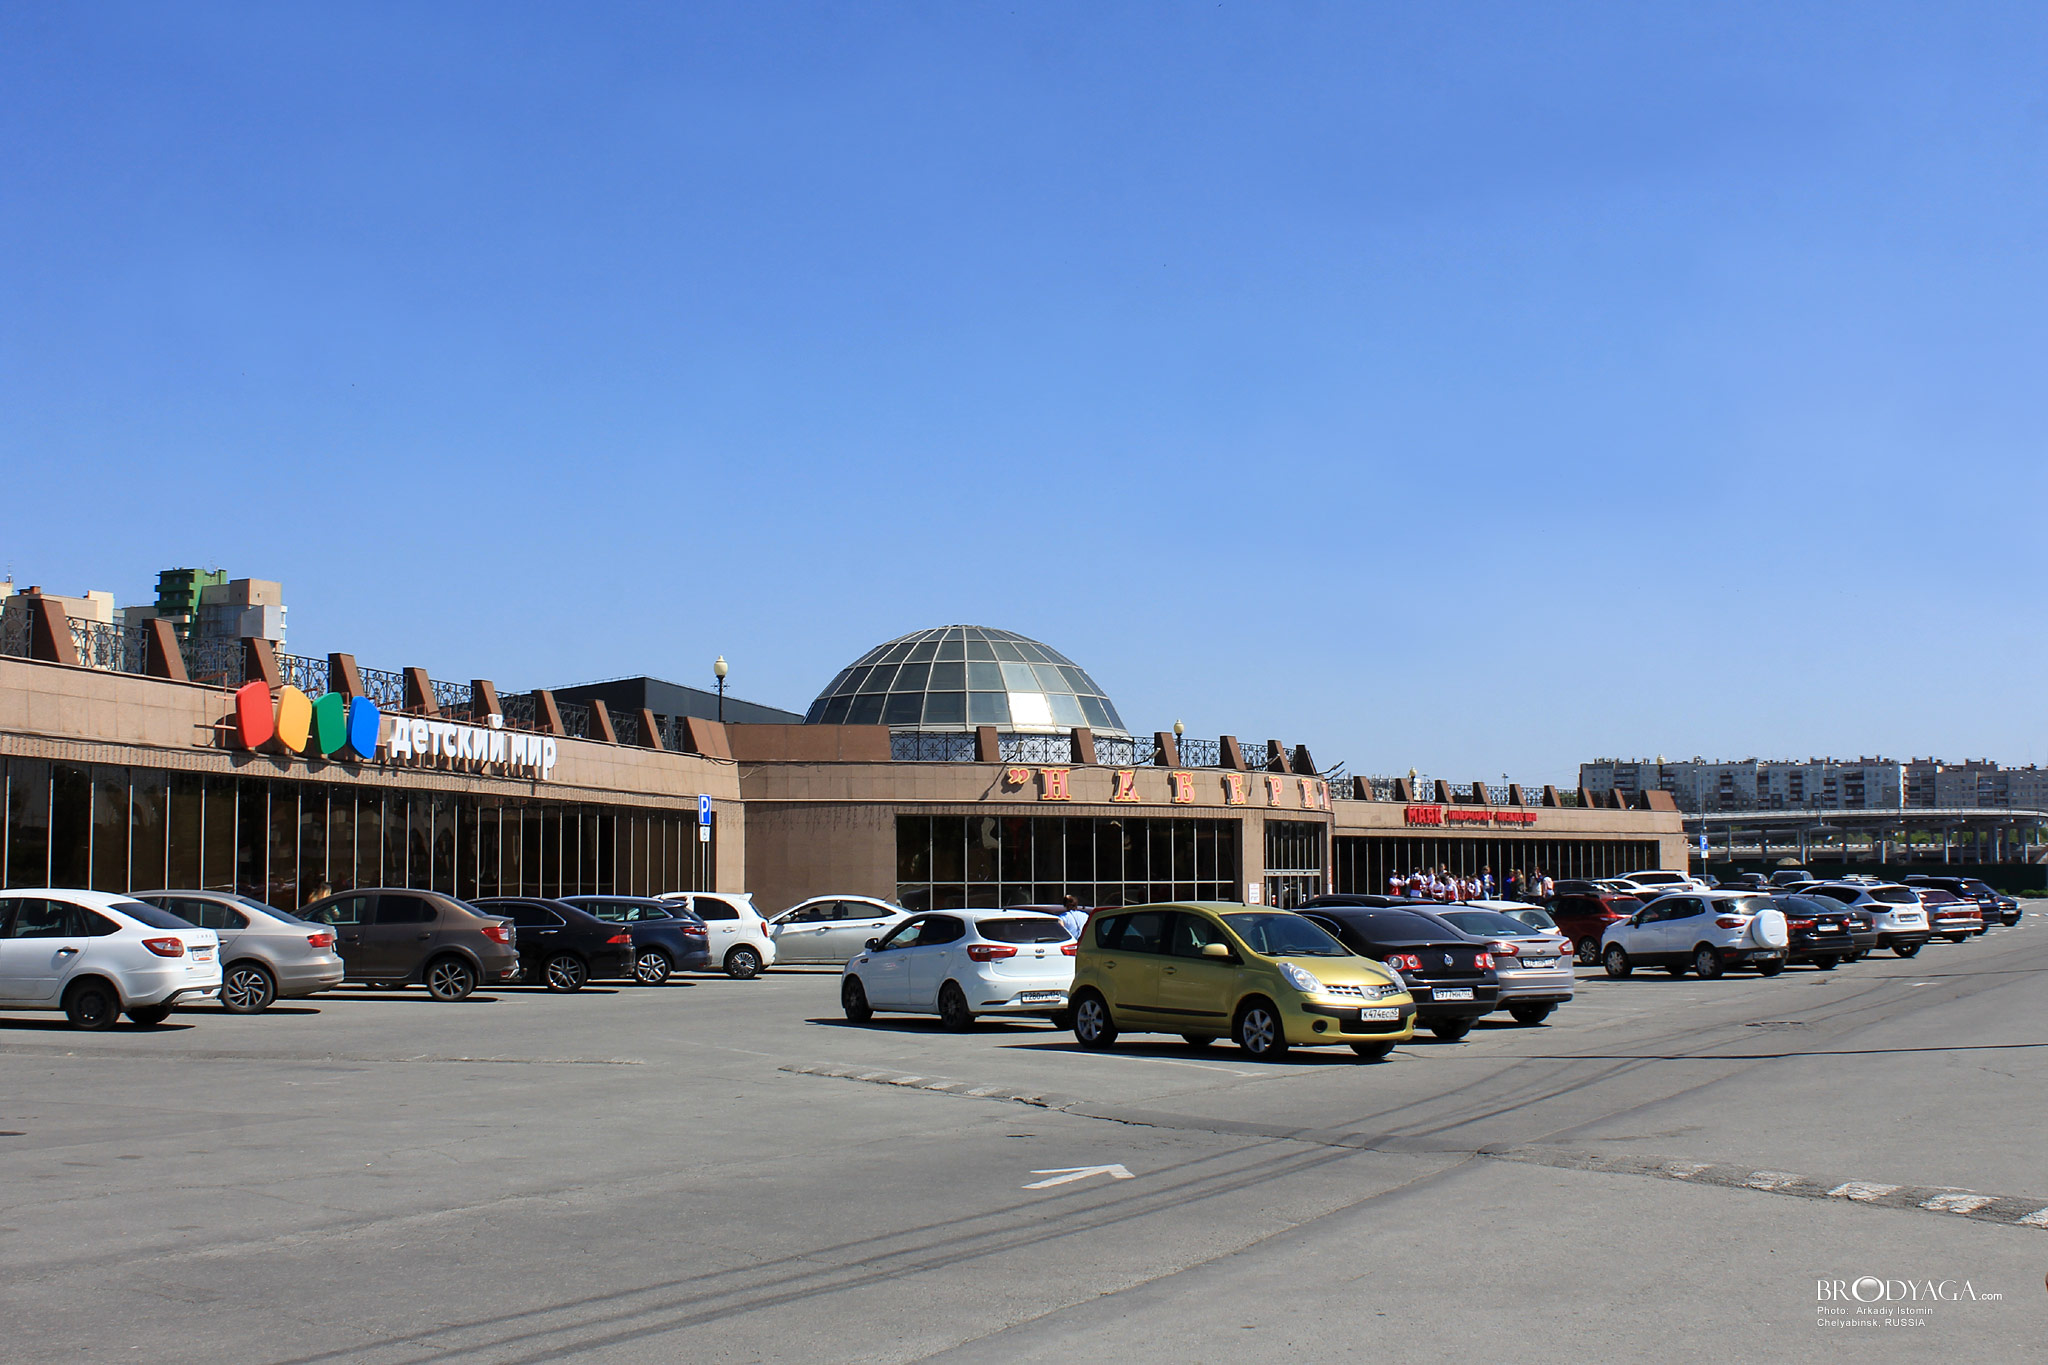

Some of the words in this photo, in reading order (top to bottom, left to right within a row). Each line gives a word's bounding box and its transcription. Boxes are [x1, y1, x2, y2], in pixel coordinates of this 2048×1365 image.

[388, 713, 505, 763] детский
[508, 733, 557, 780] мир
[1406, 805, 1443, 824] МАЯК
